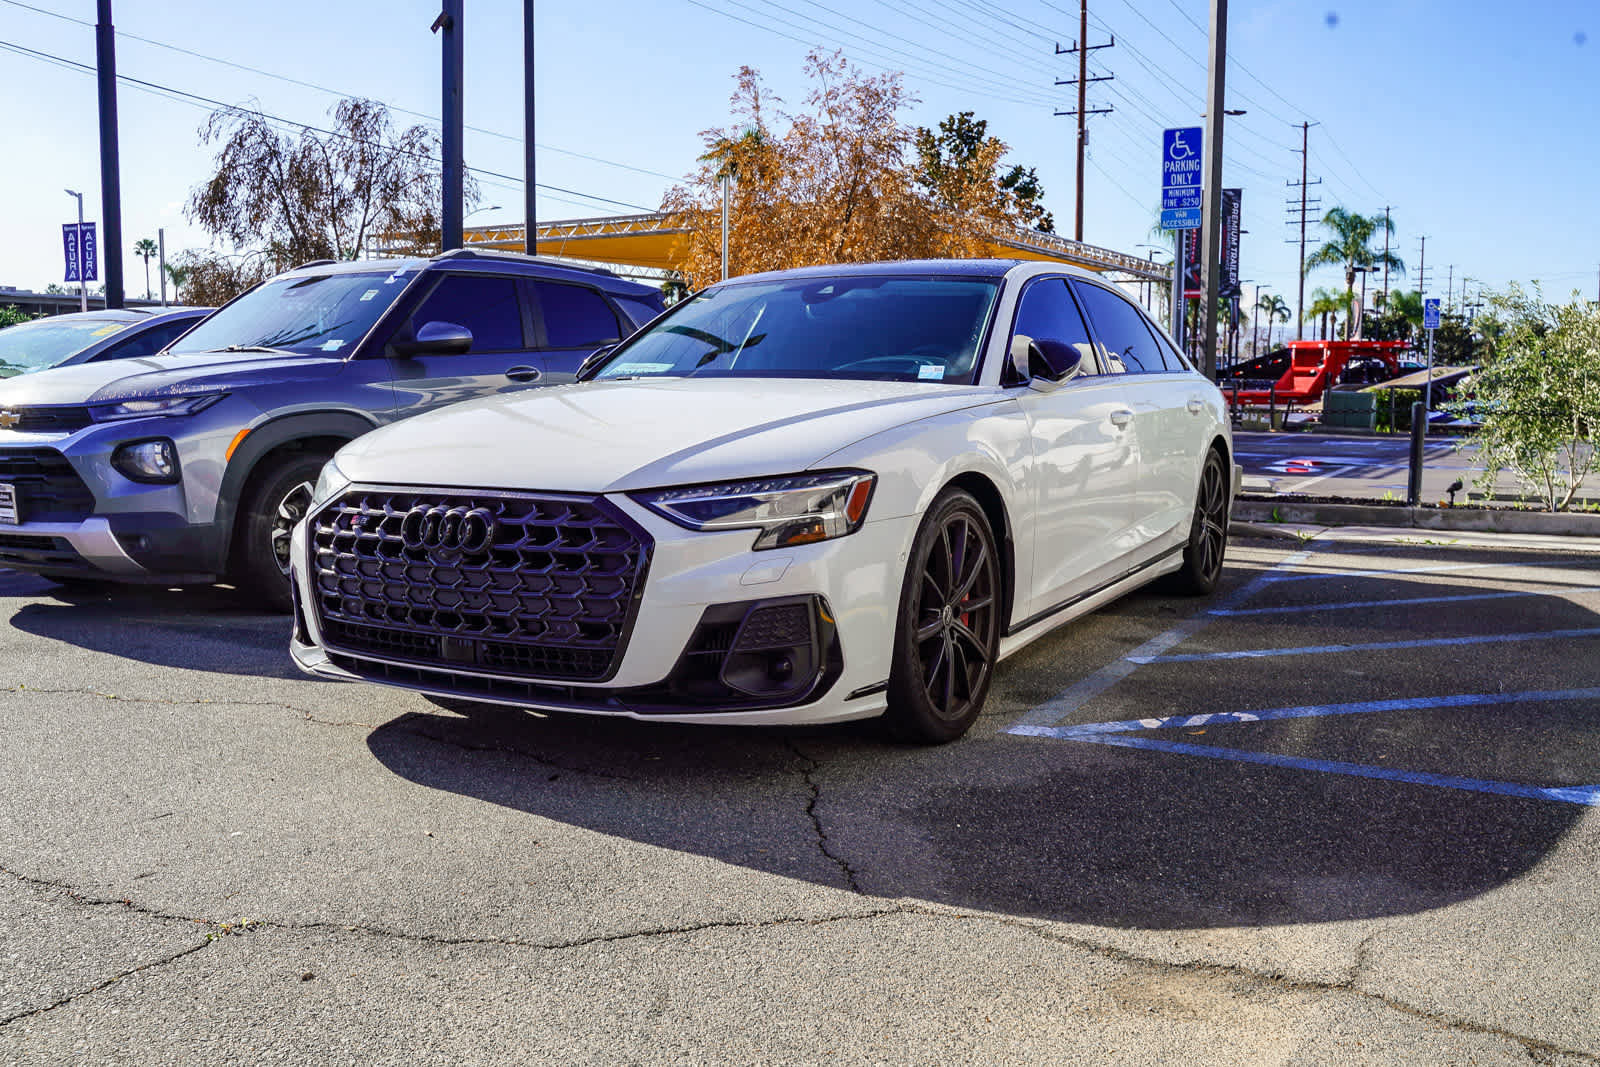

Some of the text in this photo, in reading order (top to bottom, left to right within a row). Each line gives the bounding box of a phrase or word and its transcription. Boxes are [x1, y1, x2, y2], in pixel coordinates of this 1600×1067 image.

[1164, 159, 1200, 173] PARKING
[1171, 173, 1193, 185] ONLY
[1168, 189, 1195, 197] MINIMUM
[1163, 197, 1200, 207] FINE $250
[1175, 210, 1188, 219] VAN
[1162, 217, 1200, 227] ACCESSIBLE
[1229, 202, 1239, 285] PREMIUM TRAILER
[68, 232, 76, 279] ACURA
[85, 231, 93, 278] ACURA
